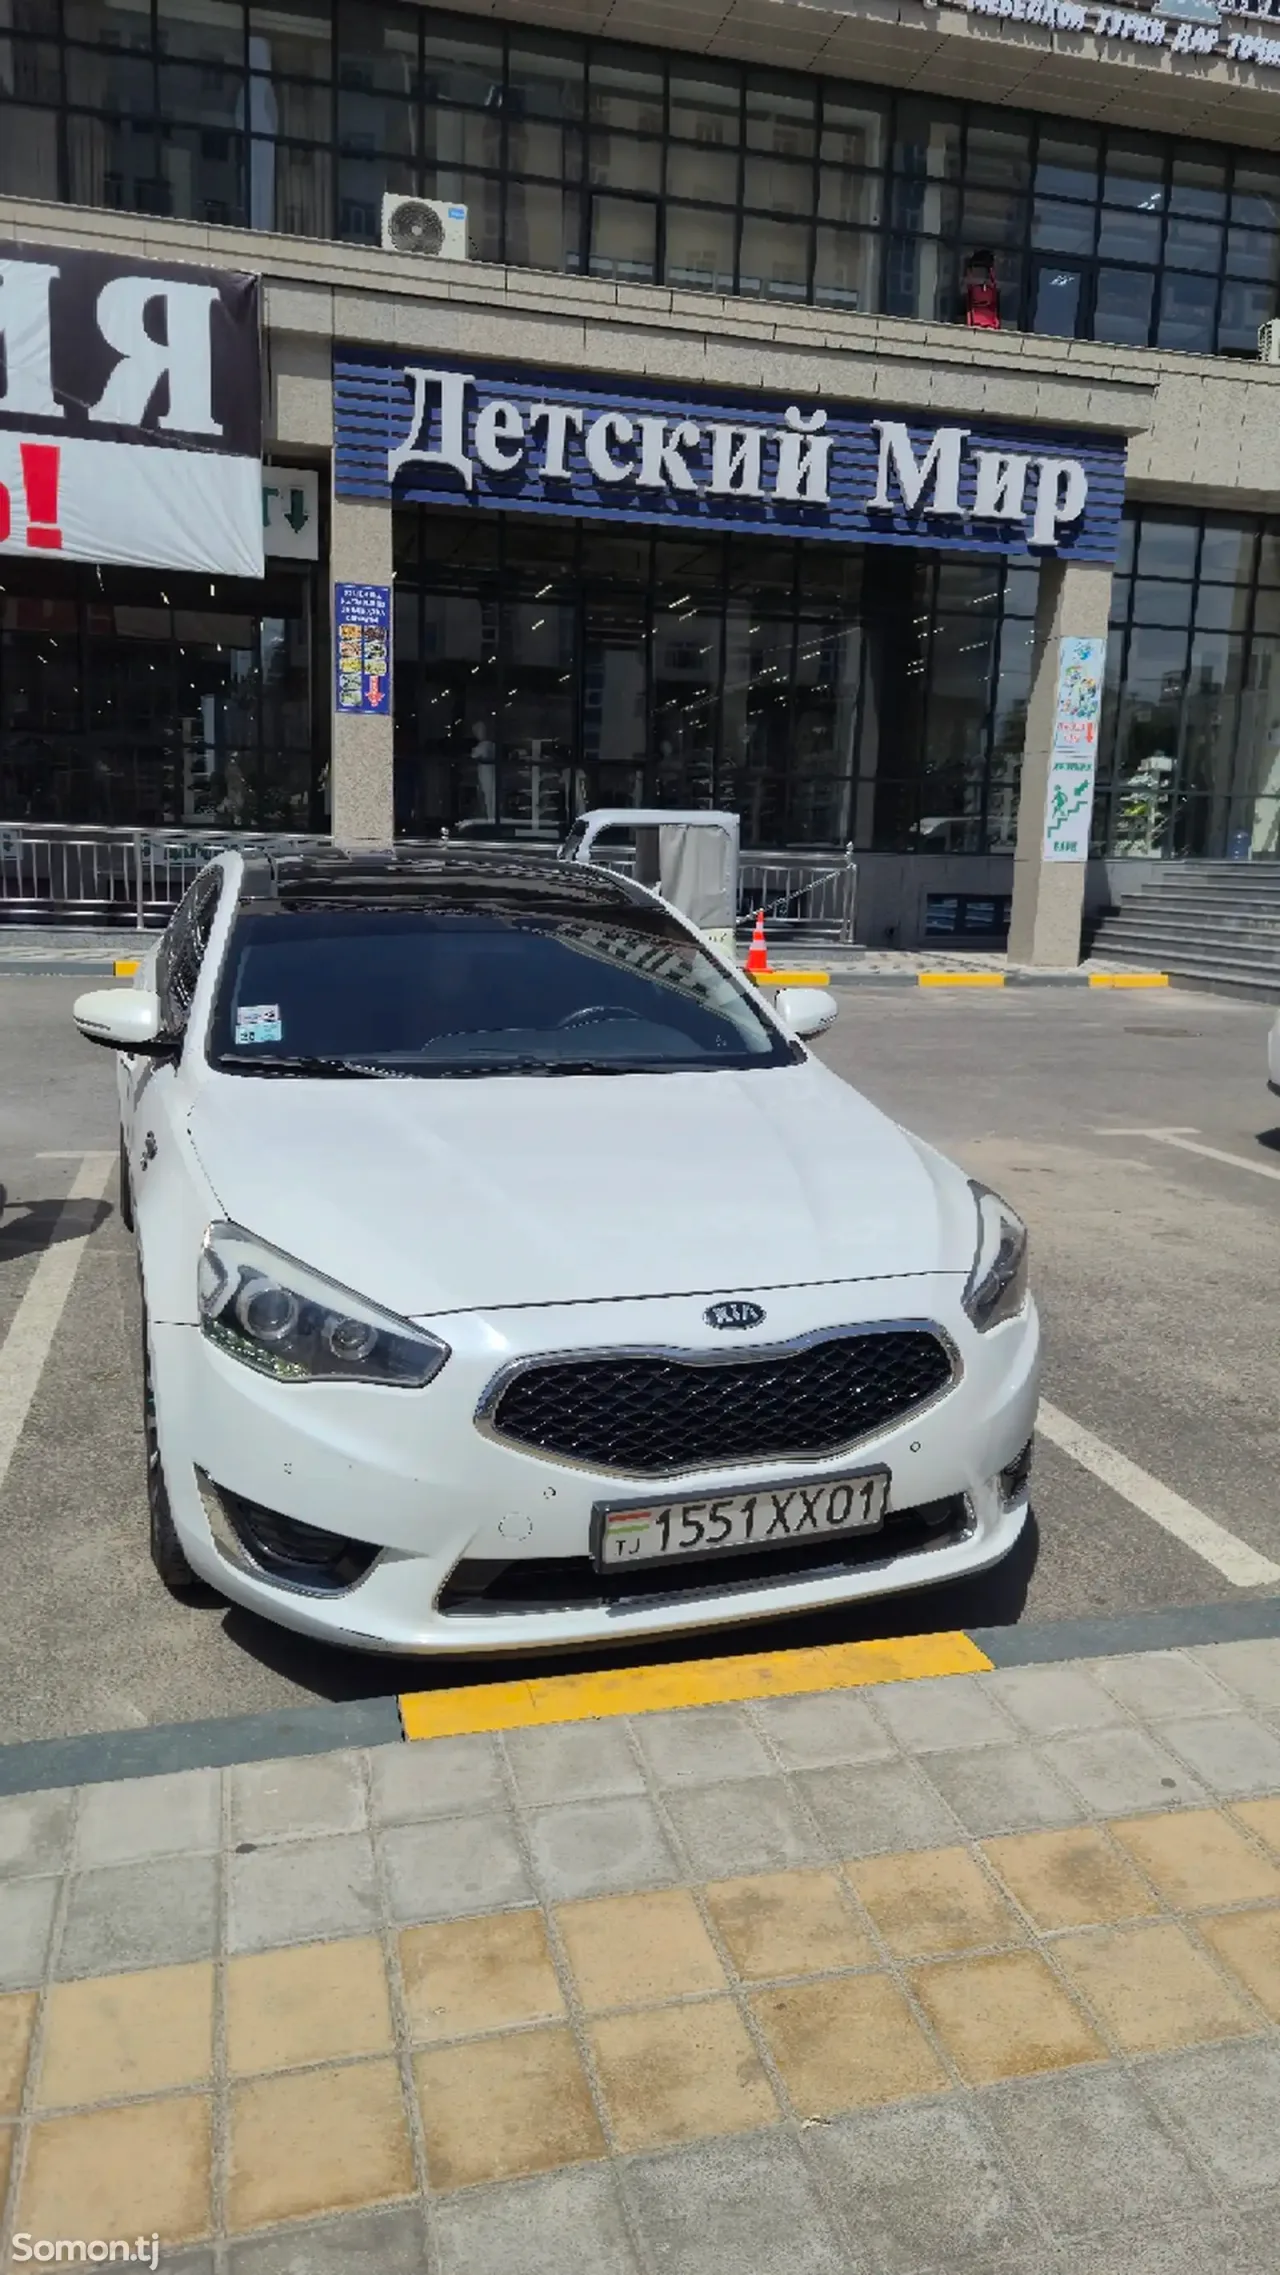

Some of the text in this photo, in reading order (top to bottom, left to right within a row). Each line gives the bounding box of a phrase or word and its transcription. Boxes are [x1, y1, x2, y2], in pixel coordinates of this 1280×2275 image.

[1170, 23, 1219, 54] ДАР
[388, 366, 1088, 545] Детский Мир
[712, 1303, 760, 1324] KIA
[615, 1480, 874, 1556] TJ 1551XX01
